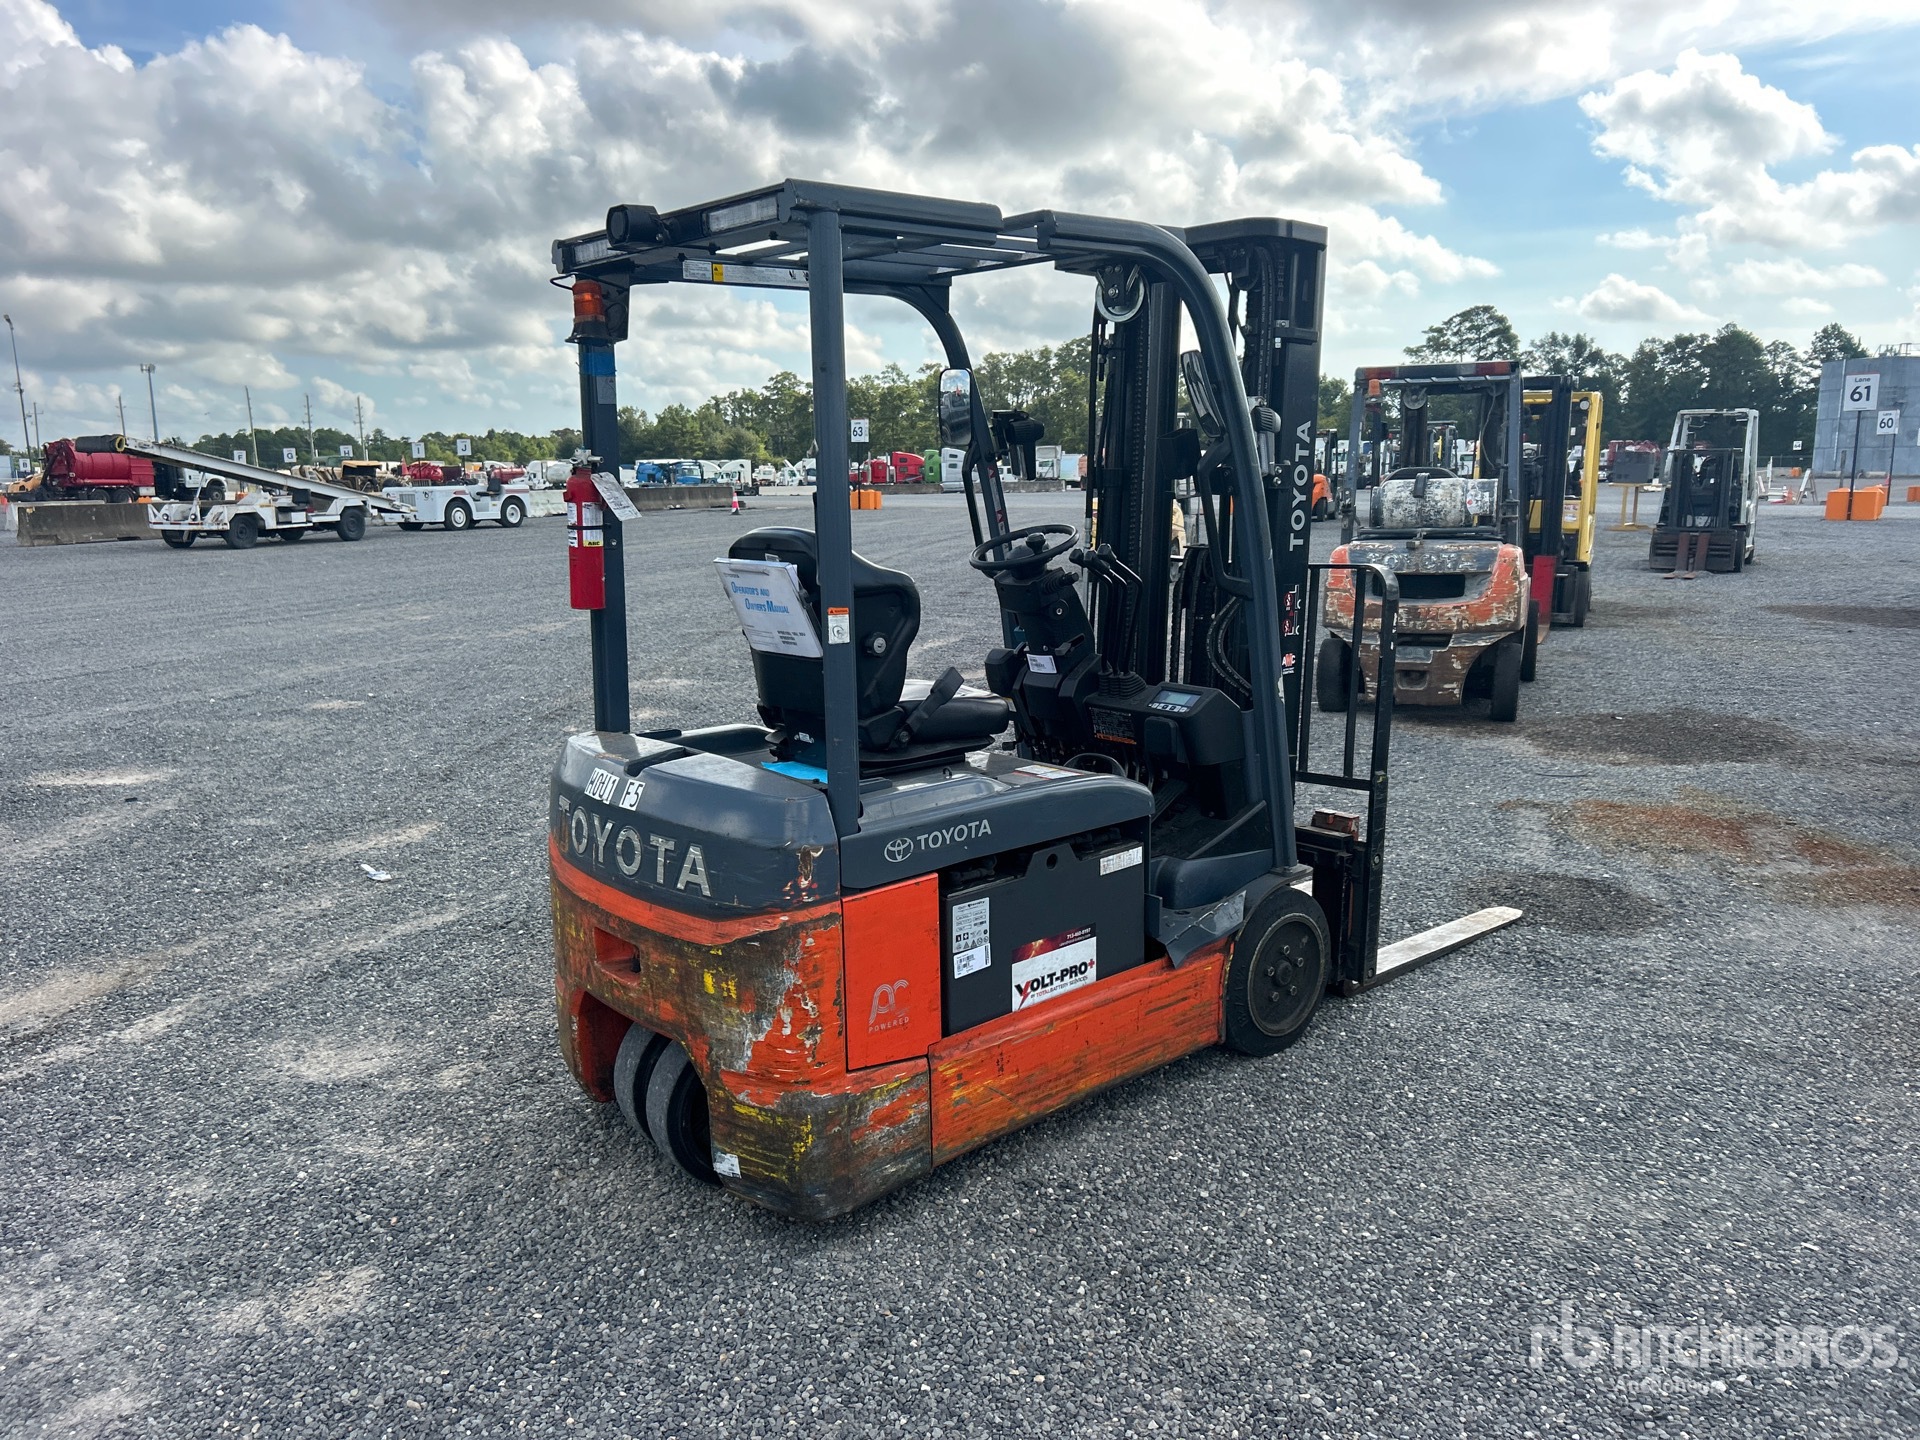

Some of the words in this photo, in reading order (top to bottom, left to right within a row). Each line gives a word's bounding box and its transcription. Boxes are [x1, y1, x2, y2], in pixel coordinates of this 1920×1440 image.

[1850, 385, 1871, 402] 61
[852, 426, 863, 437] 63
[1879, 417, 1894, 429] 60
[287, 452, 294, 460] G
[1289, 420, 1311, 552] TOYOTA
[621, 781, 644, 808] F5
[916, 819, 992, 850] TOYOTA
[558, 794, 712, 897] TOYOTA
[868, 1016, 910, 1034] POWERED
